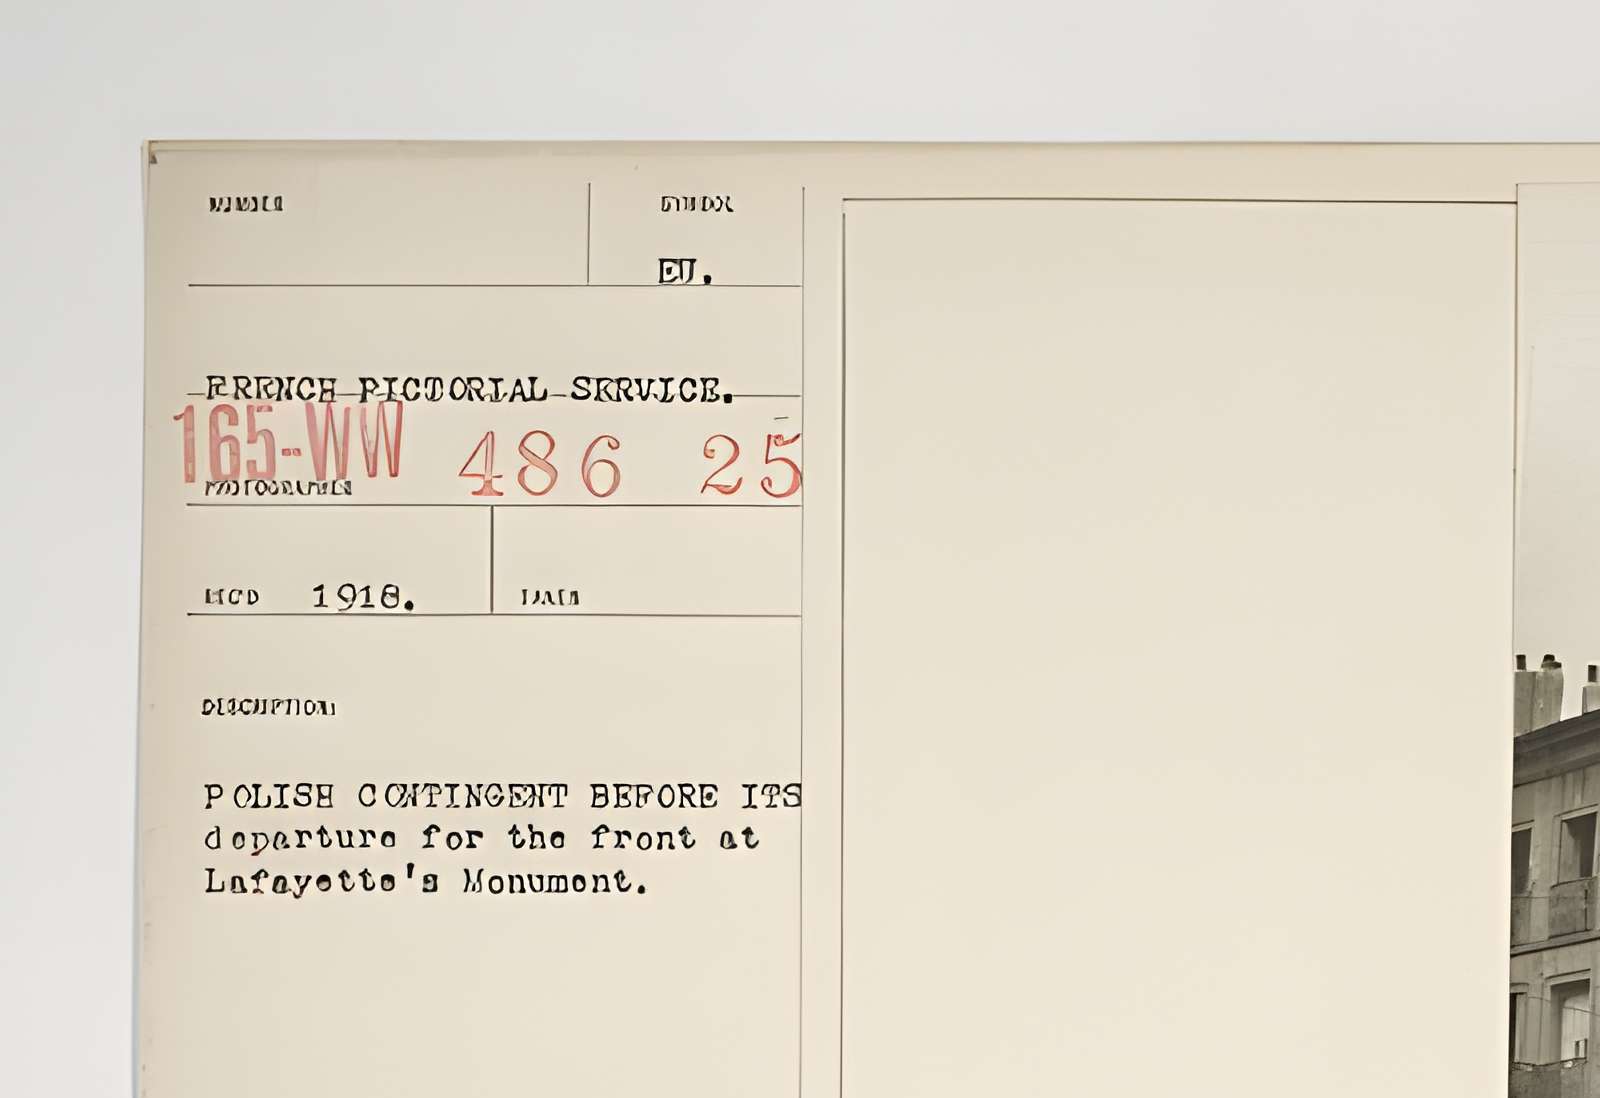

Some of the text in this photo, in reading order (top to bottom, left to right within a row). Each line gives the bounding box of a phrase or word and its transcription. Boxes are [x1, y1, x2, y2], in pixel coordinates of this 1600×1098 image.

[358, 376, 548, 403] PICTORIAL
[174, 399, 800, 499] 165-WW 486 25
[312, 582, 415, 612] 1918.
[204, 782, 801, 810] POLISH CONTINGENT BEFORE ITS
[204, 823, 760, 857] departure for the front at
[204, 862, 646, 899] Lafayette's Monument.
